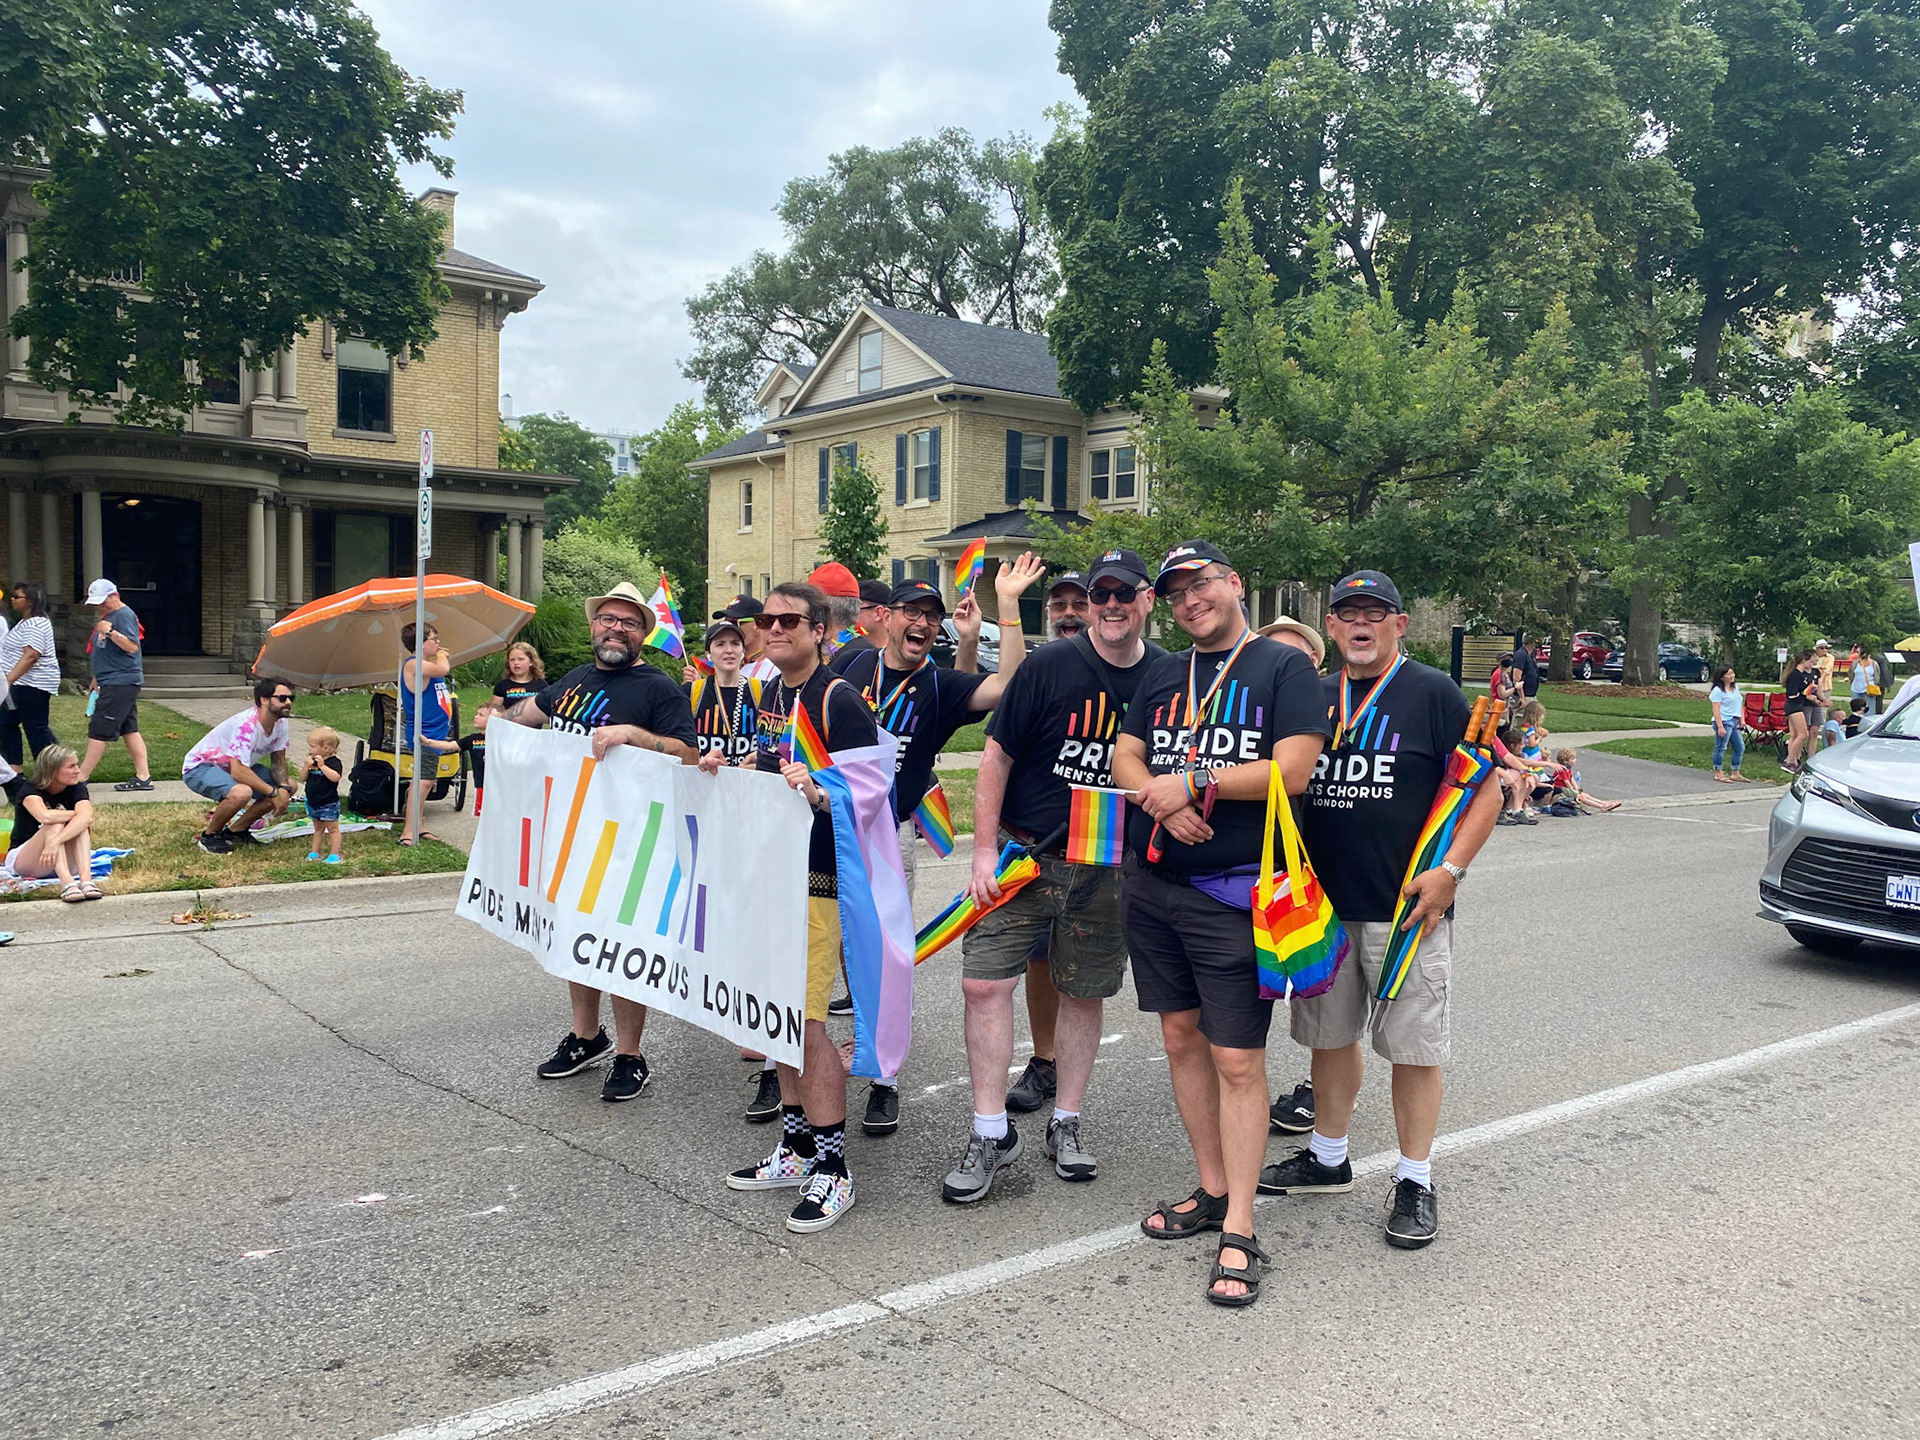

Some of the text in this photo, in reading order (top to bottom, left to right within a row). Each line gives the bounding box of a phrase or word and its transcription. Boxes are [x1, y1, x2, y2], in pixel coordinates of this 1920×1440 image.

[1058, 739, 1116, 770] PRI
[1152, 727, 1262, 760] PRIDE
[1052, 762, 1095, 784] MEN'S
[1150, 753, 1186, 767] MEN'S
[1310, 753, 1396, 783] RIDE
[1313, 798, 1354, 809] LONDON
[1326, 784, 1394, 800] CHORUS
[572, 933, 689, 1000] CHORUS
[703, 974, 802, 1047] LONDON
